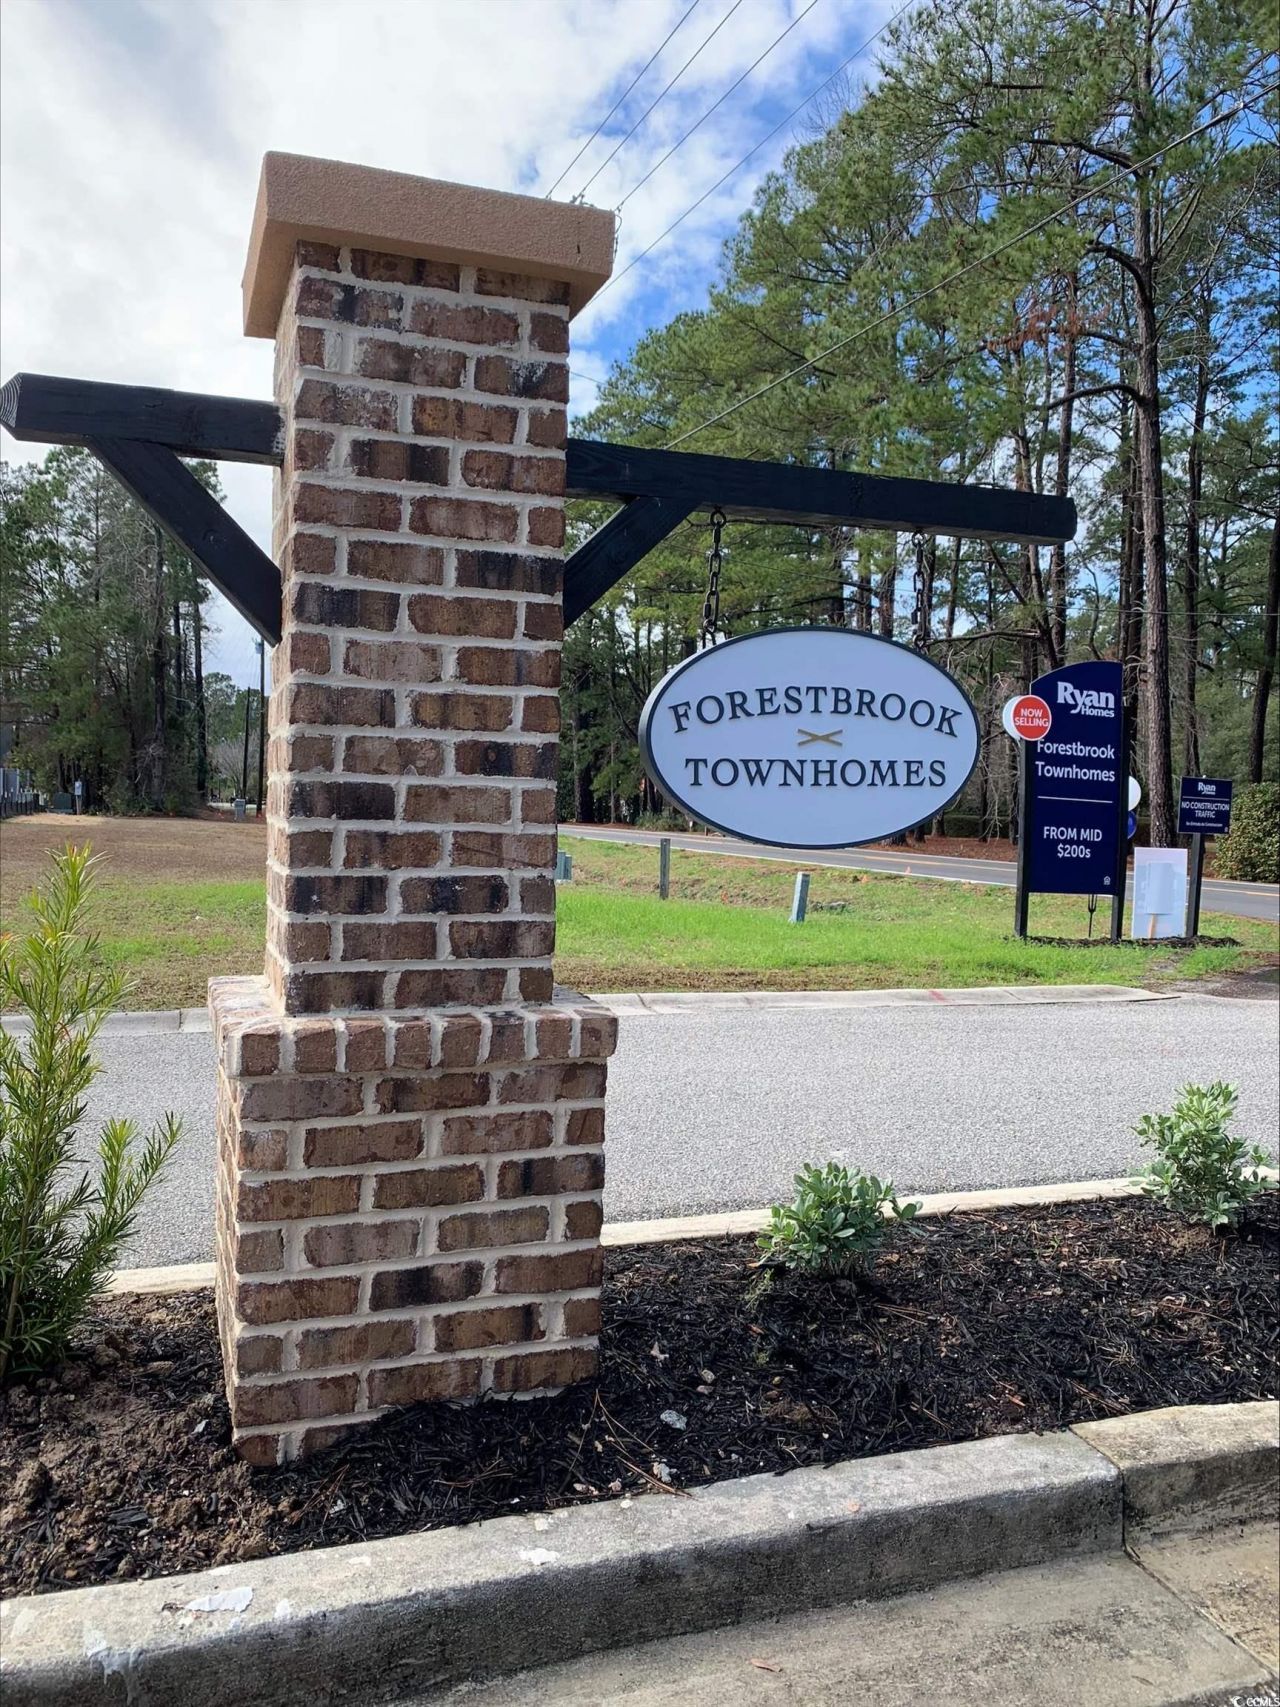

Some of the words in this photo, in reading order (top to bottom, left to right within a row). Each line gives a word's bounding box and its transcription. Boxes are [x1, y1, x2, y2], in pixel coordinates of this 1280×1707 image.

[1057, 681, 1115, 714] Ryan
[668, 686, 962, 738] FORESTBROOK
[1020, 708, 1043, 717] NOW
[1081, 705, 1115, 718] Homes
[1014, 717, 1049, 727] SELLING
[1037, 739, 1115, 760] Forestbrook
[685, 758, 946, 787] TOWNHOMES
[1035, 761, 1115, 782] Townhomes
[1198, 782, 1216, 795] Ryan
[1181, 801, 1190, 809] NO
[1190, 801, 1230, 811] CONSTRUCTION
[1195, 810, 1216, 818] TRAFFIC
[1043, 826, 1077, 841] FROM
[1080, 828, 1103, 842] MID
[1057, 843, 1091, 858] $200s
